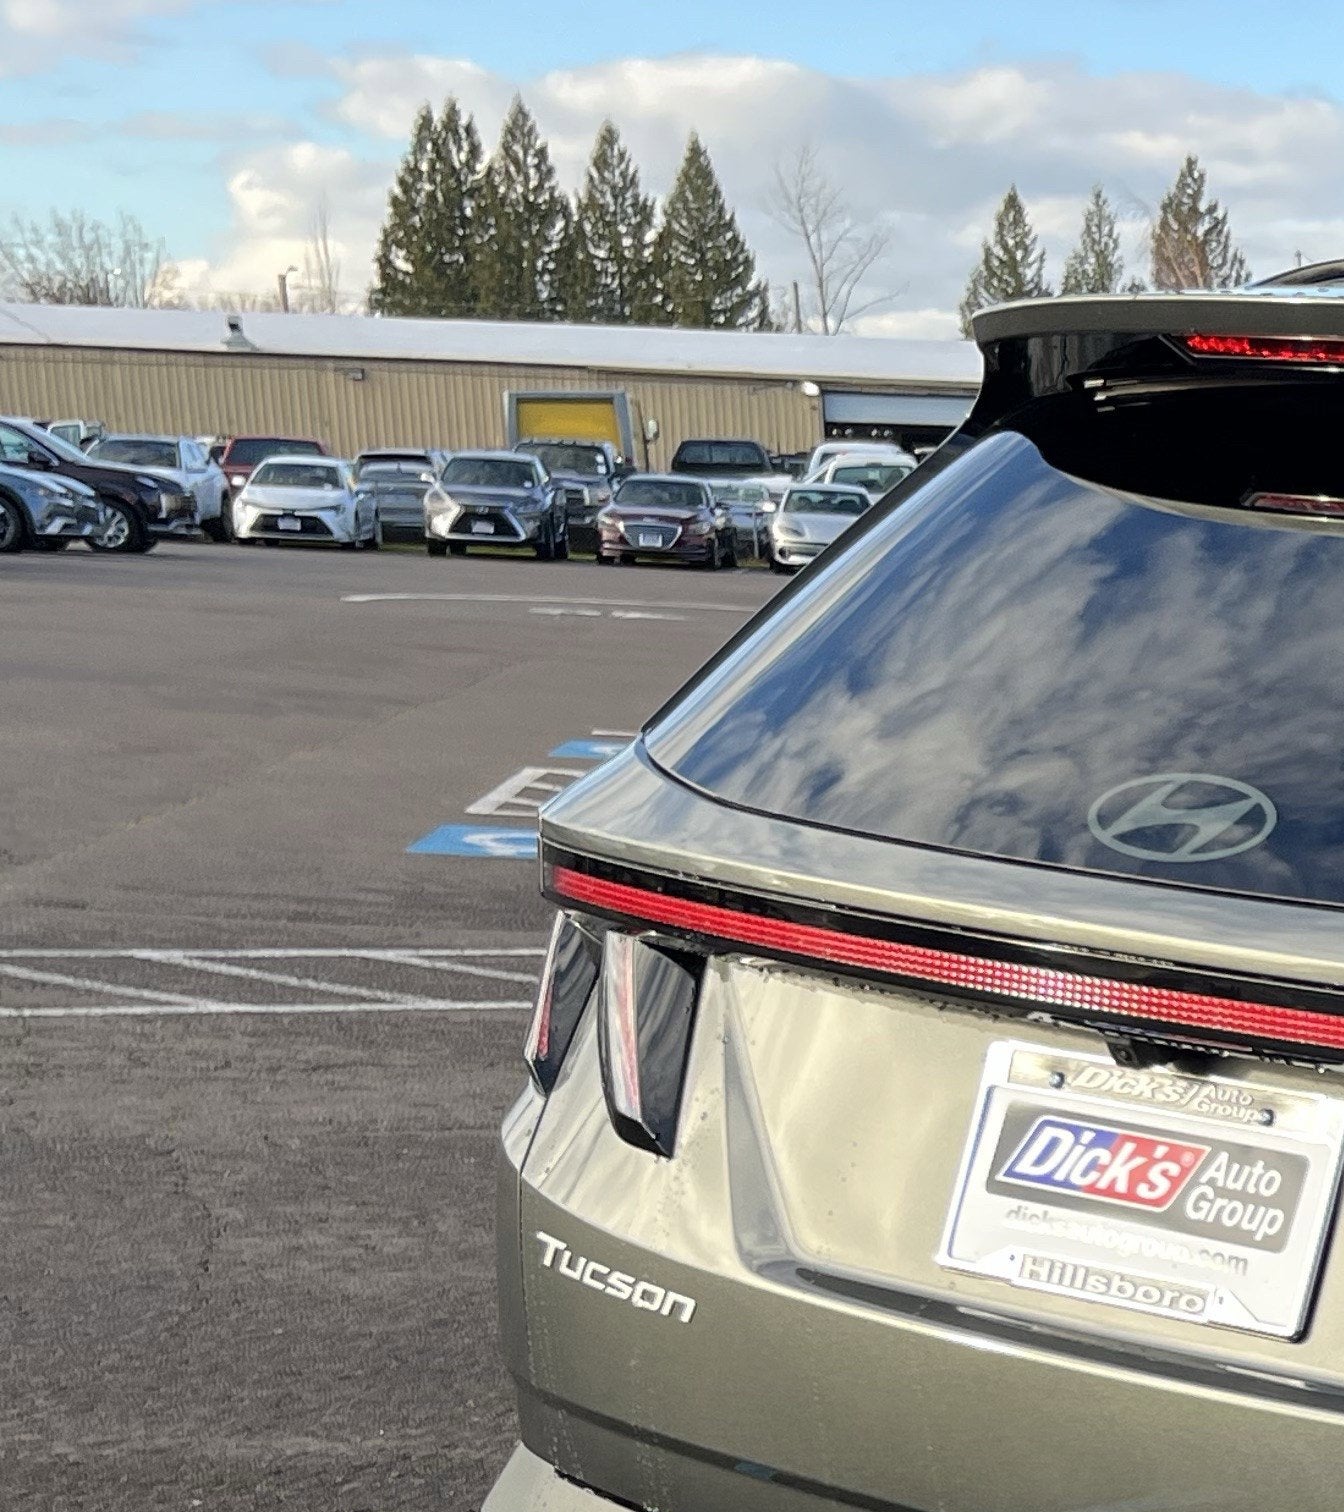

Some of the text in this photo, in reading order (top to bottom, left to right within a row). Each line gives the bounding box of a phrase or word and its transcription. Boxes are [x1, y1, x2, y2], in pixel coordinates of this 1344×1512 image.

[1194, 1097, 1262, 1122] Group
[1200, 1084, 1253, 1107] Auto
[1015, 1126, 1282, 1201] Dick's Auto
[1005, 1205, 1249, 1277] dicksautogroup.com
[1186, 1184, 1286, 1241] Group
[1018, 1253, 1207, 1316] Hillsboro
